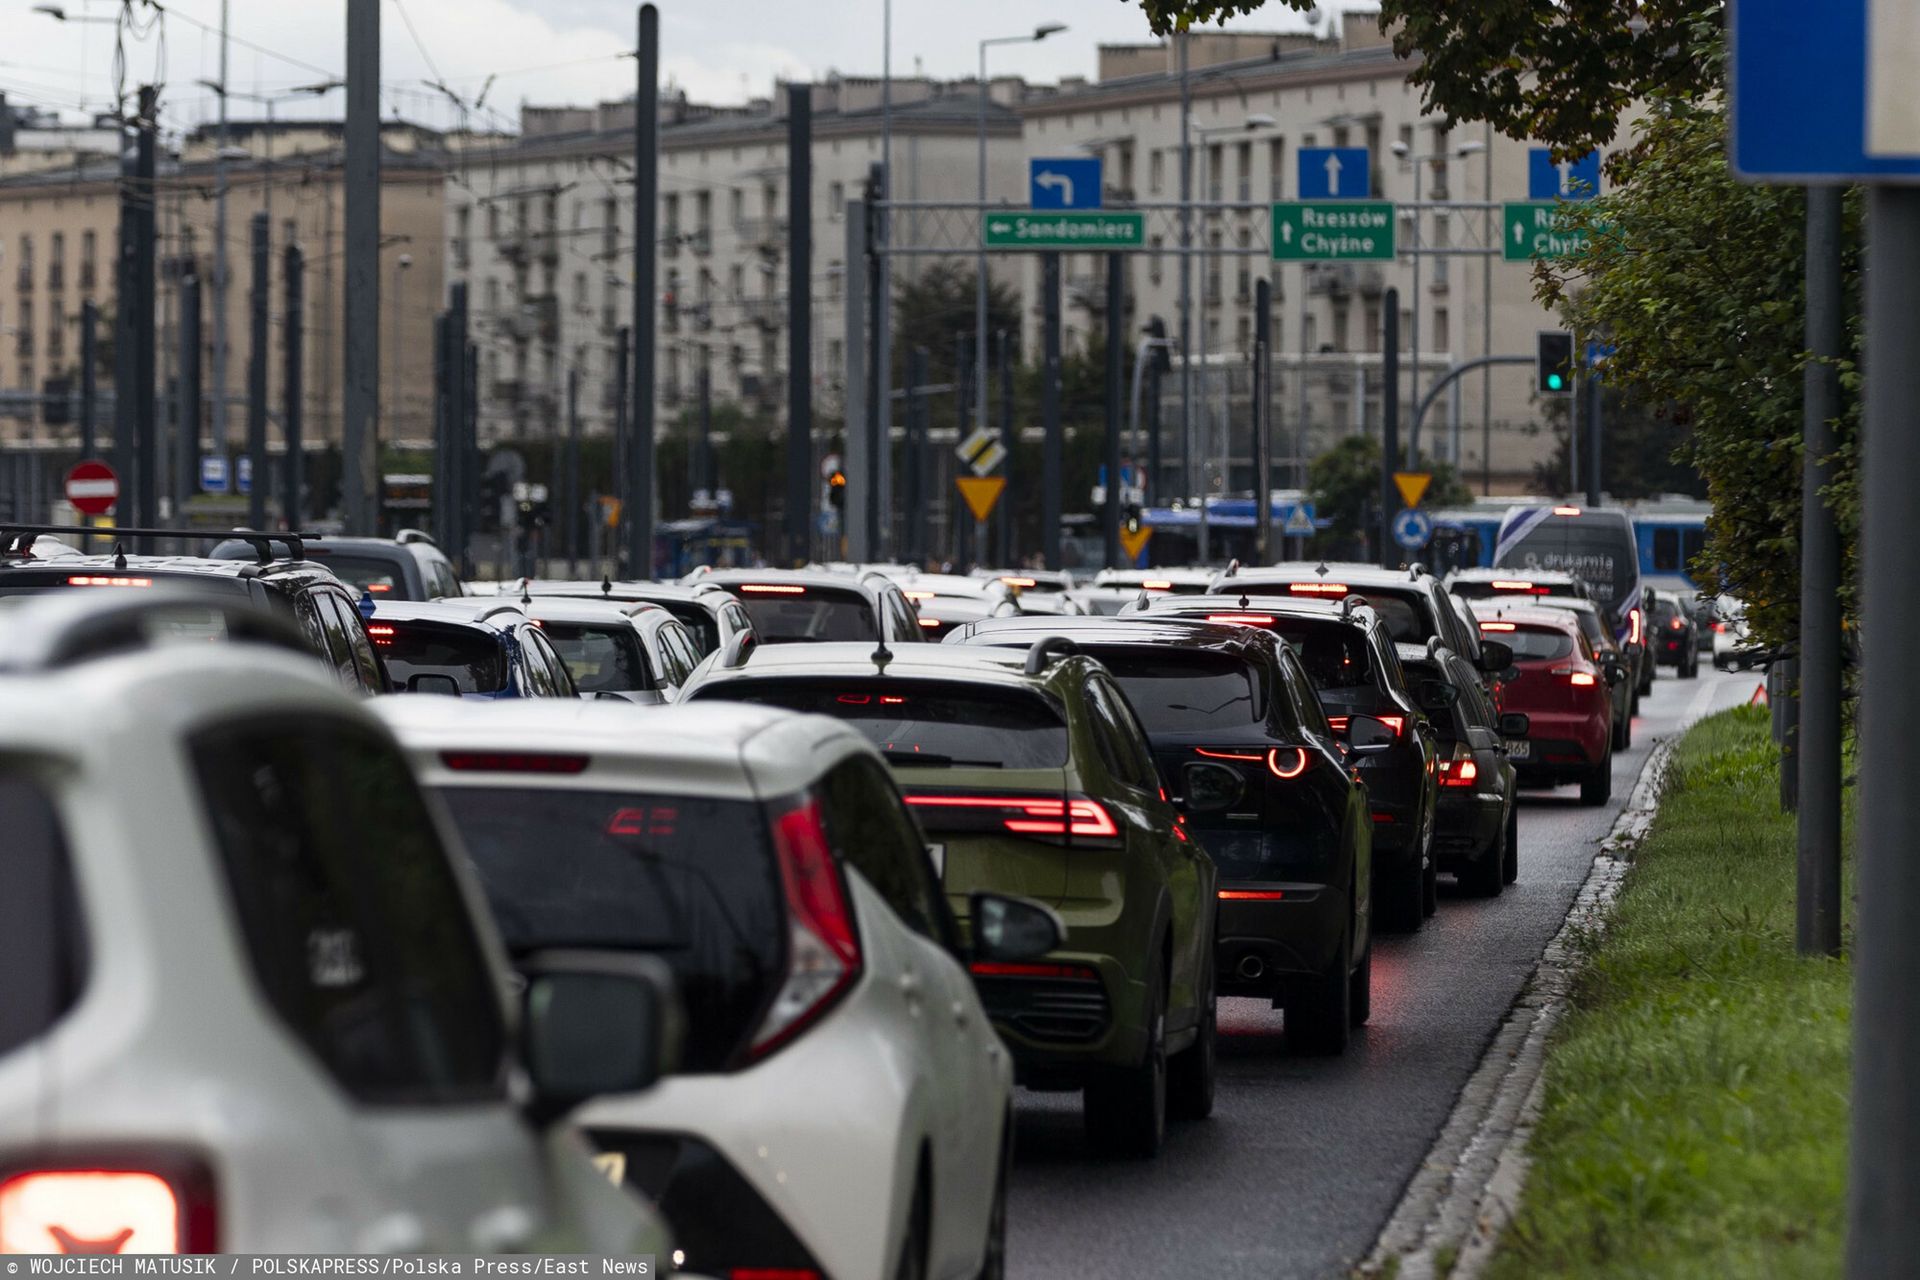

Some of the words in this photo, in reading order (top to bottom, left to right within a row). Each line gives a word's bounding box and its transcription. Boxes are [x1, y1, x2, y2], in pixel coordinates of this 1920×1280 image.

[1016, 217, 1135, 239] Sandomierz
[1301, 207, 1387, 228] Rzeszów
[1301, 232, 1375, 257] Chyżne
[1544, 553, 1614, 569] drukarnia
